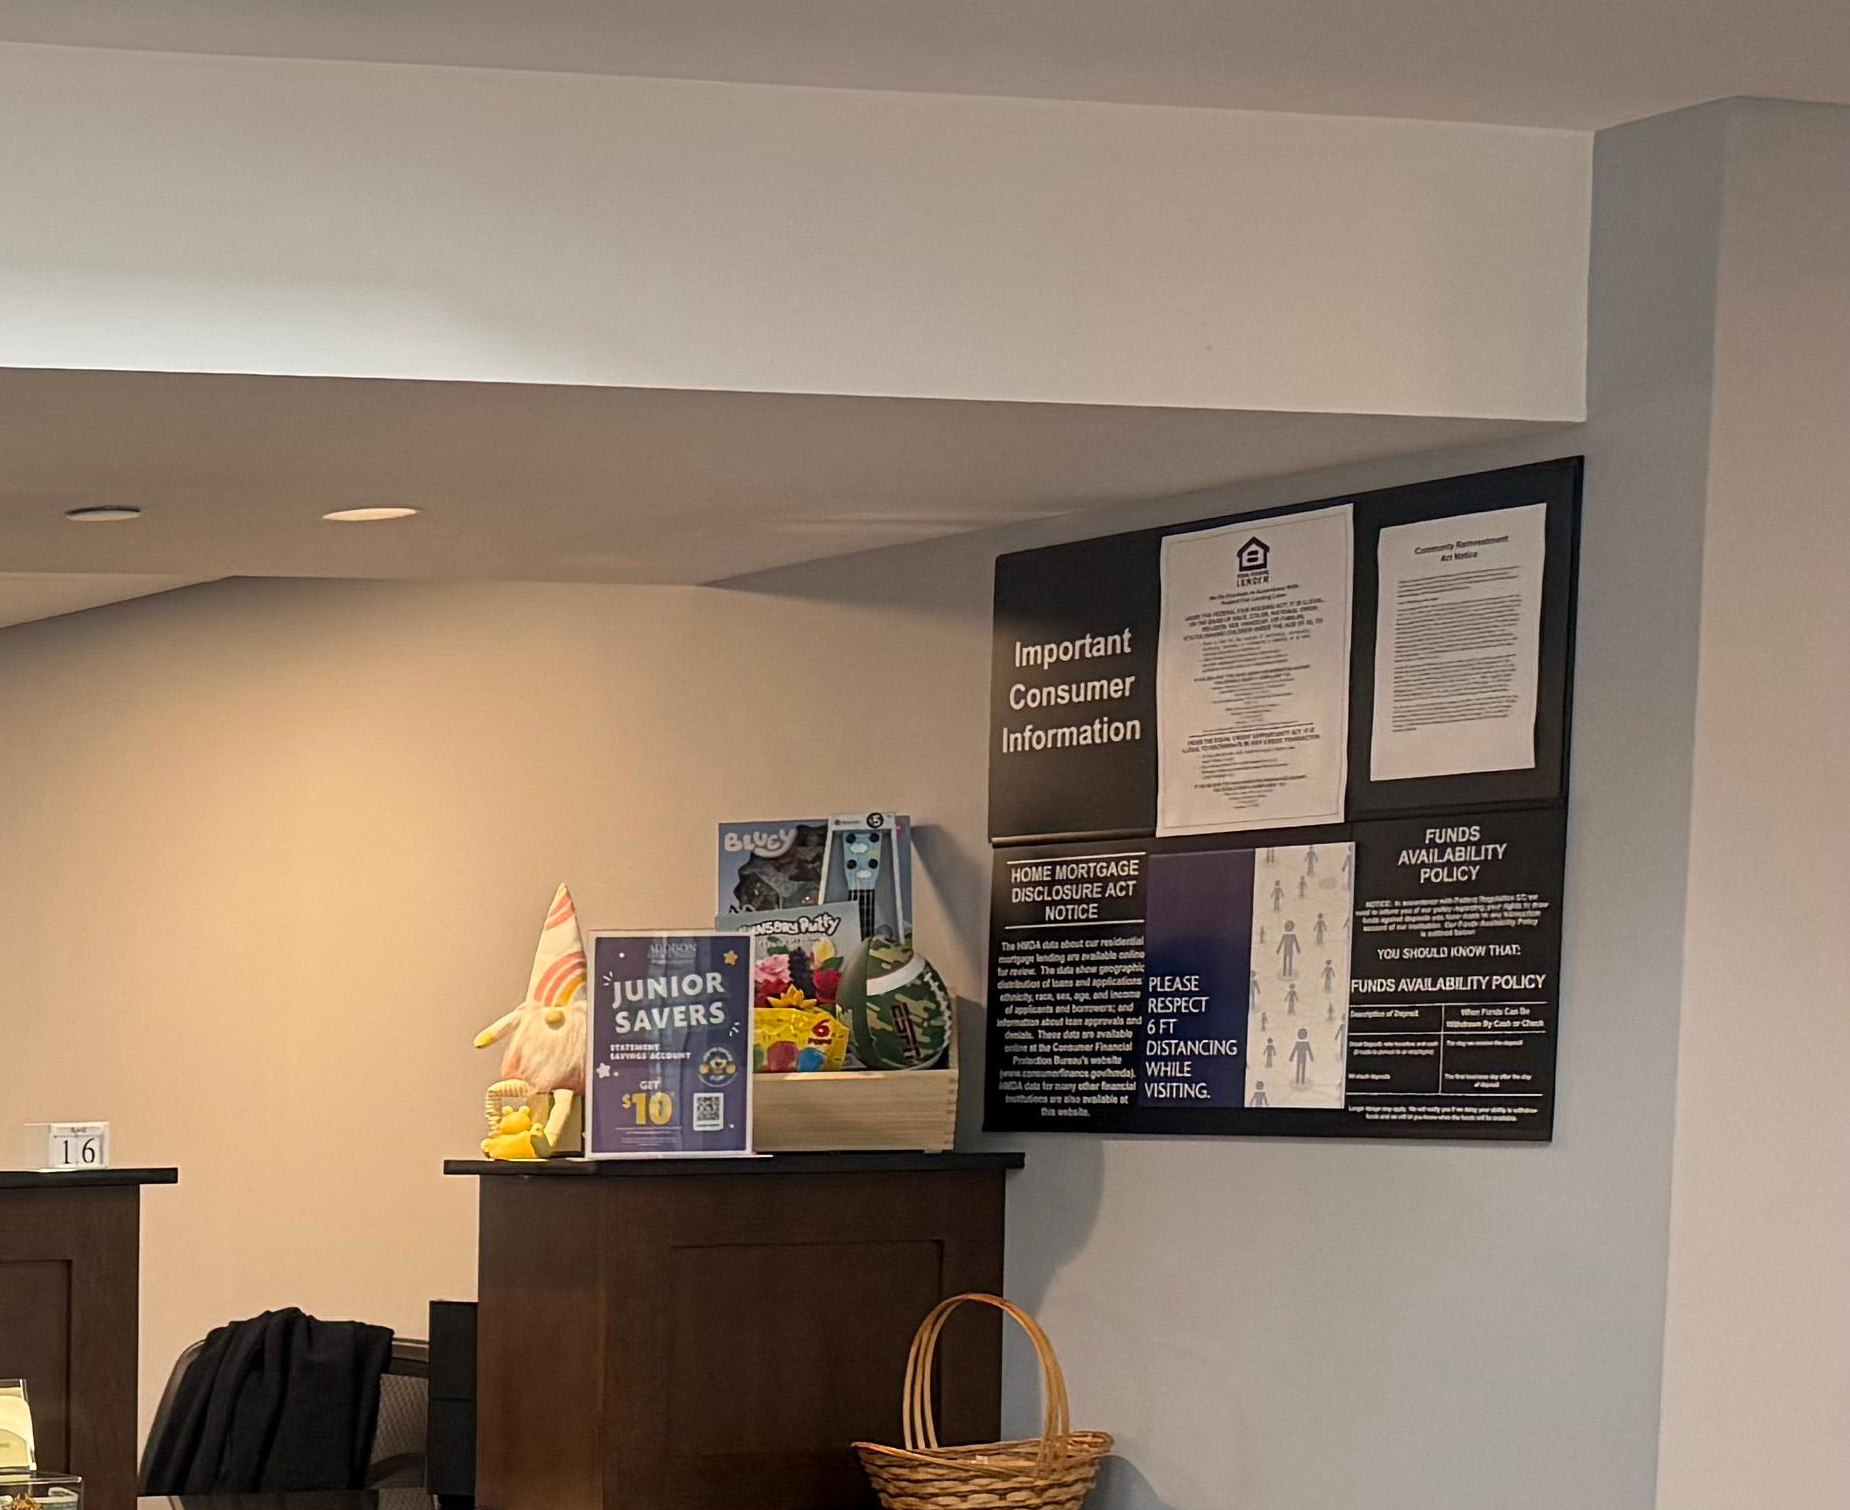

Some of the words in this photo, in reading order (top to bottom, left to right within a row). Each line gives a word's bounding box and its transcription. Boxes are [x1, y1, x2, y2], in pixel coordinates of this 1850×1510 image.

[1015, 628, 1132, 670] Important
[1009, 676, 1135, 710] Consumer
[1002, 717, 1141, 753] Information
[1425, 826, 1481, 844] FUNDS
[1398, 843, 1507, 865] AVAILABILITY
[1011, 866, 1052, 883] HOME
[1055, 860, 1139, 879] MORTGAGE
[1420, 866, 1480, 883] POLICY
[1012, 883, 1102, 903] DISCLOSURE
[1105, 881, 1136, 897] ACT
[1045, 904, 1098, 920] NOTICE
[1378, 948, 1400, 960] YOU
[1402, 947, 1448, 959] SHOULD
[1451, 945, 1485, 958] KNOW
[612, 972, 726, 1009] JUNIOR
[1149, 976, 1199, 992] PLEASE
[1351, 978, 1395, 993] FUNDS
[1398, 976, 1489, 992] AVAILABILITY
[1492, 974, 1546, 989] POLICY
[1148, 997, 1210, 1013] RESPECT
[615, 1001, 725, 1034] SAVERS
[812, 1019, 830, 1038] 6
[1147, 1019, 1155, 1035] 6
[1159, 1019, 1178, 1034] FT
[1146, 1040, 1237, 1056] DISTANCING
[1146, 1061, 1192, 1077] WHILE
[640, 1081, 661, 1090] GET
[1145, 1083, 1210, 1098] VISITING.
[63, 1138, 95, 1164] 16
